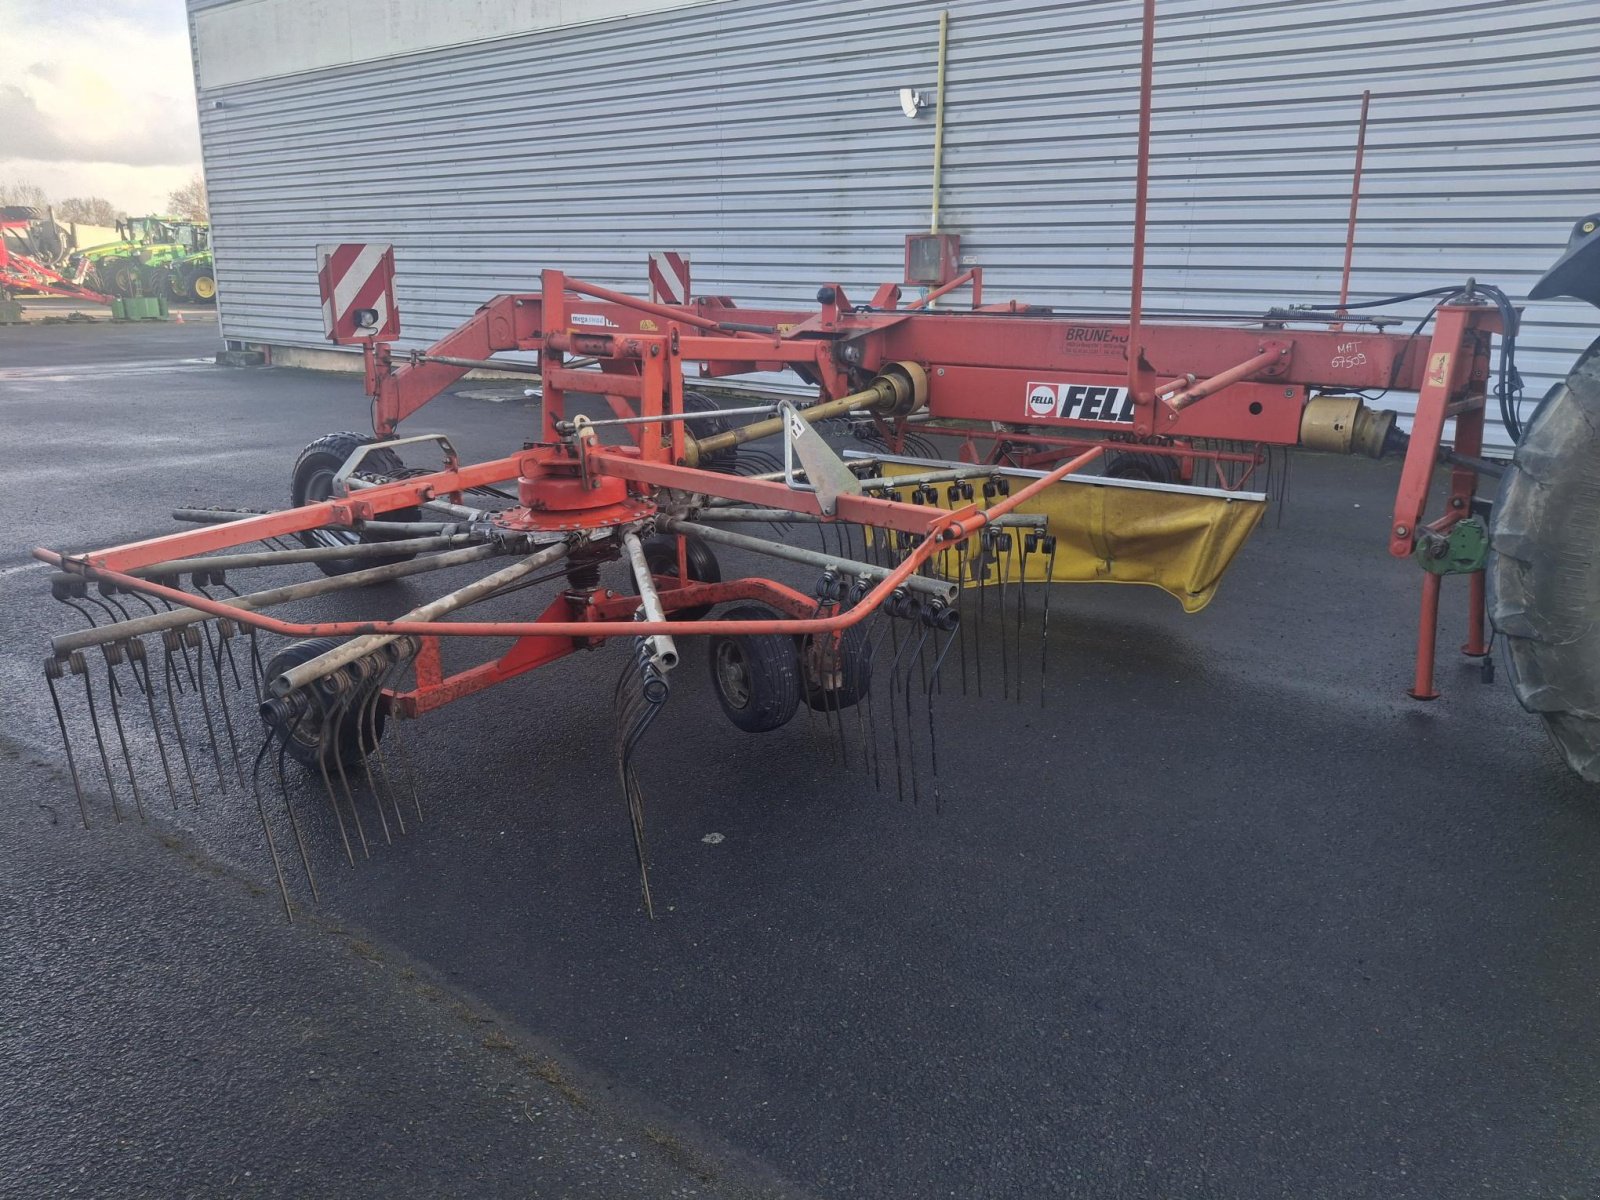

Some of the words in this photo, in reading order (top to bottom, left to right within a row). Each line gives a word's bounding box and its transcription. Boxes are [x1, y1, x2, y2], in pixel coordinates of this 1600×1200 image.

[1337, 341, 1362, 354] MAT
[1030, 395, 1054, 405] FELLA
[1060, 386, 1135, 422] FELL
